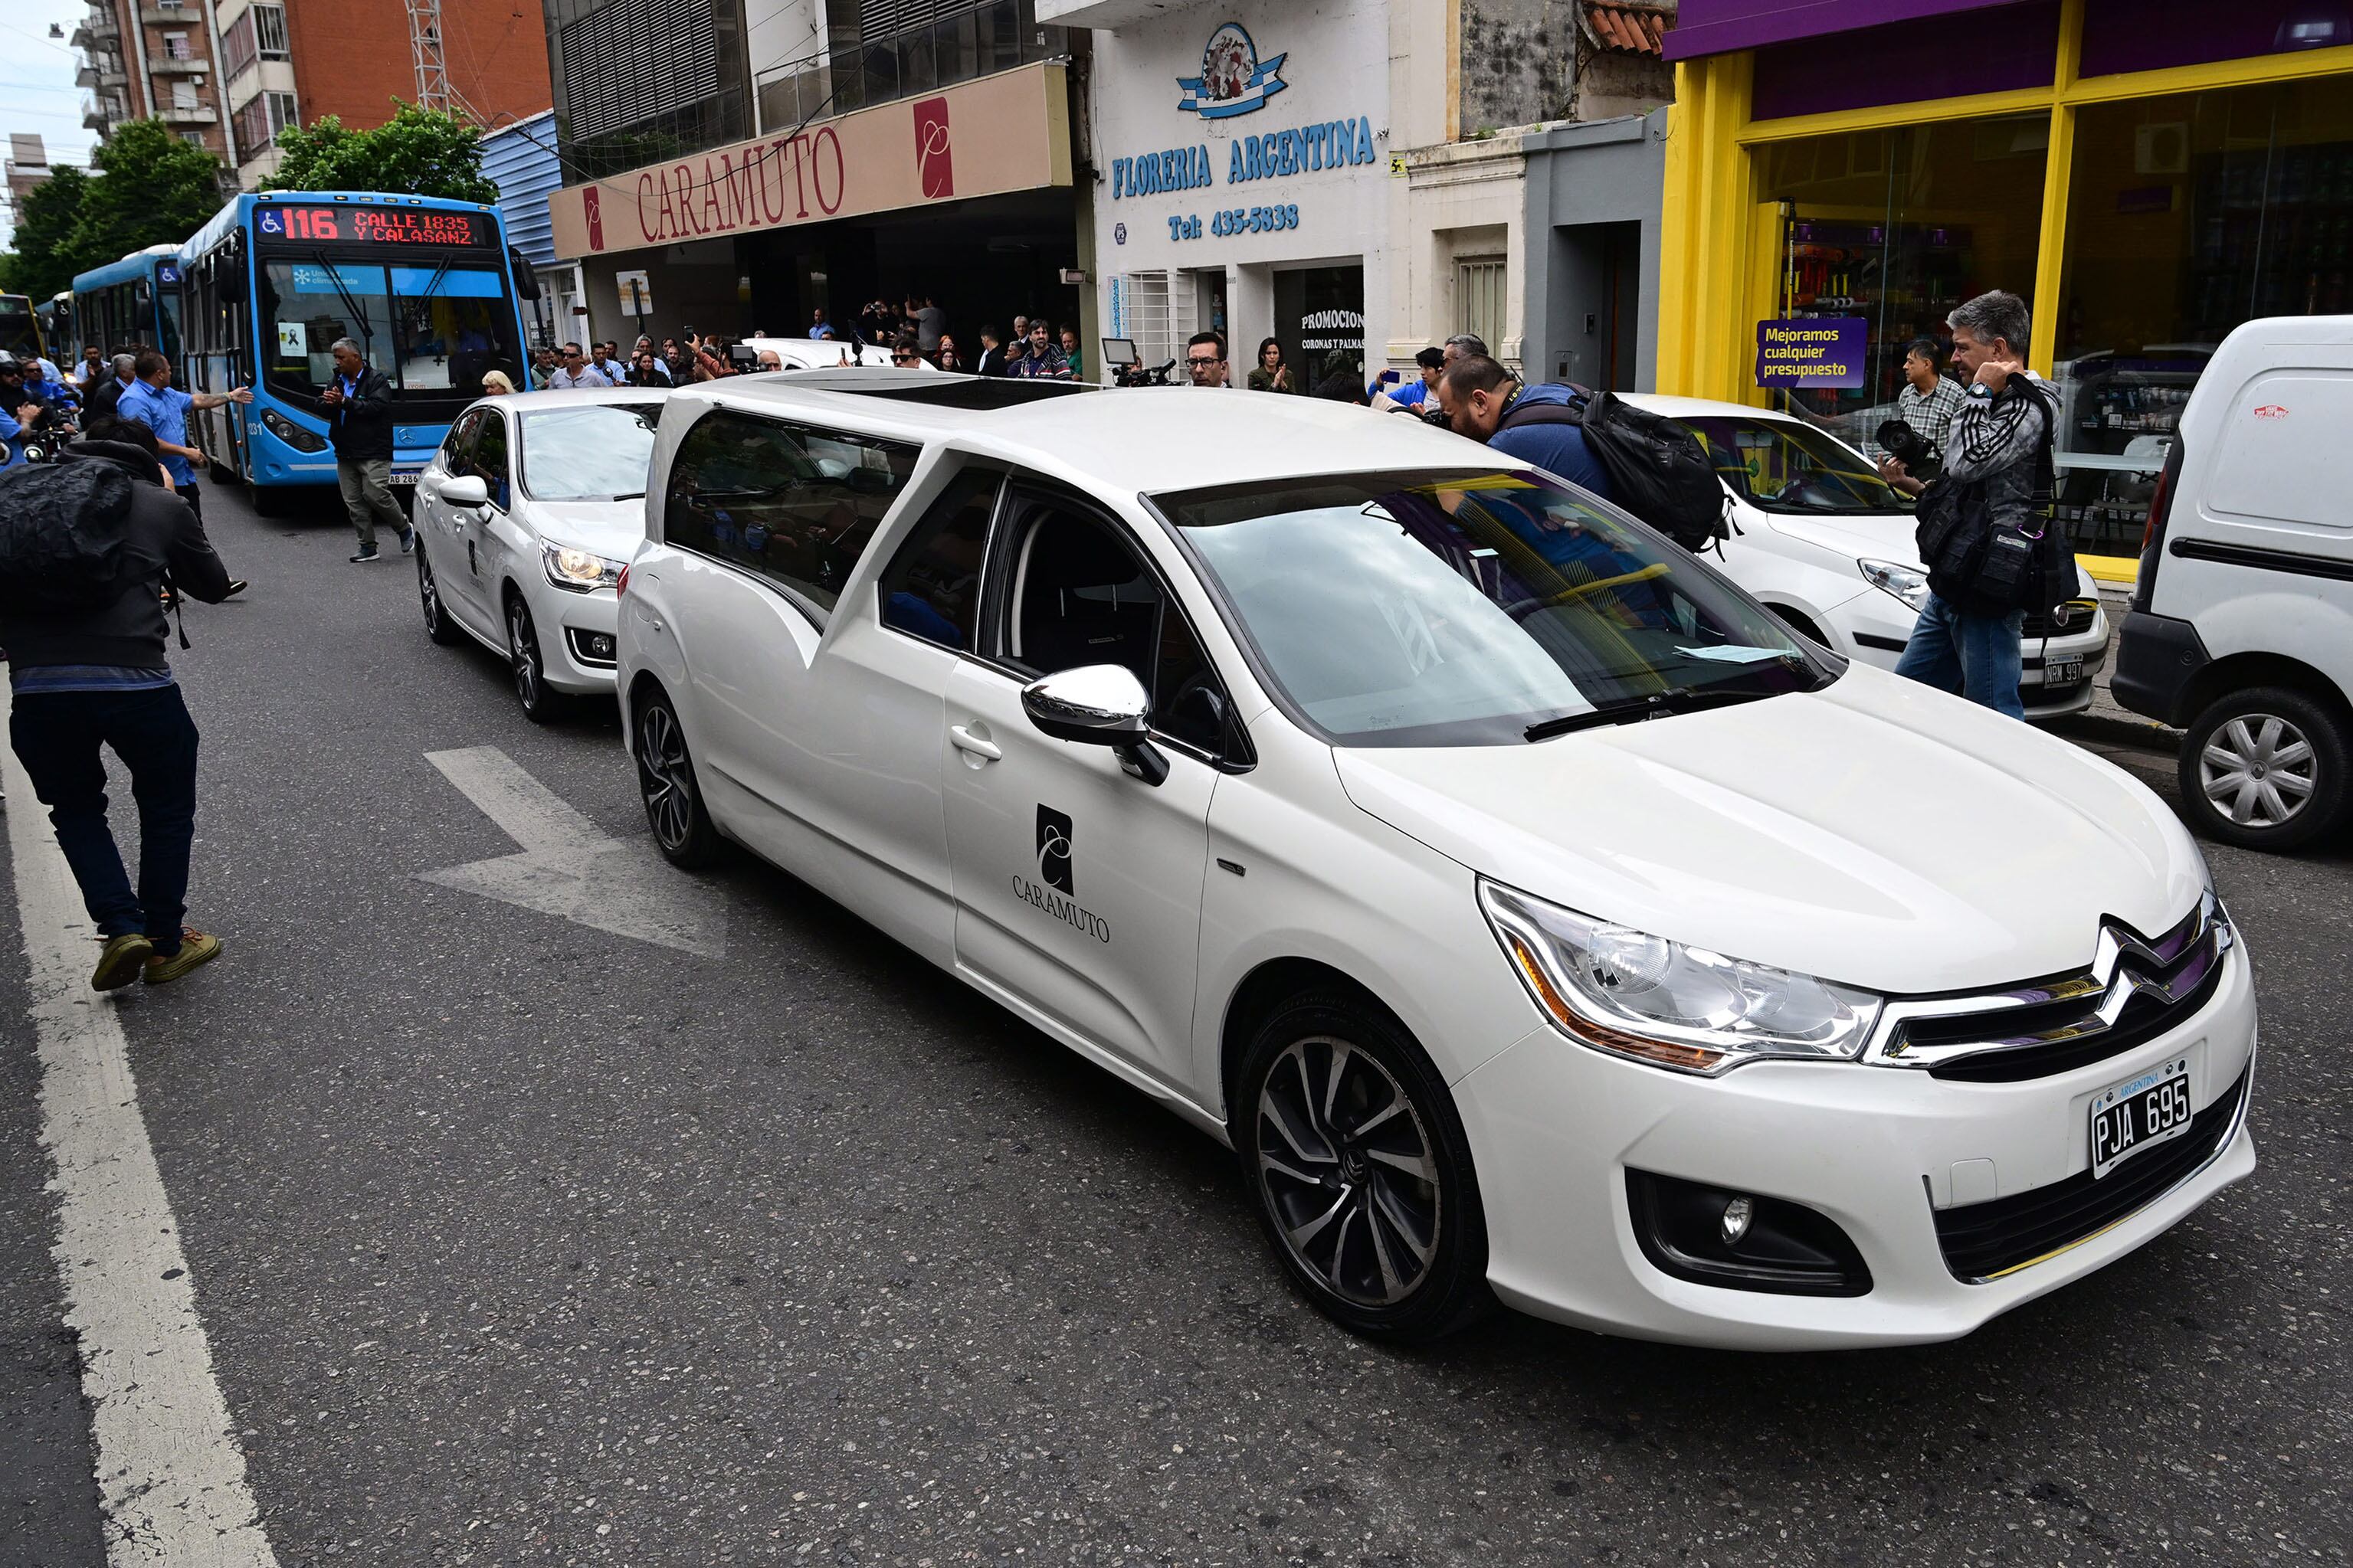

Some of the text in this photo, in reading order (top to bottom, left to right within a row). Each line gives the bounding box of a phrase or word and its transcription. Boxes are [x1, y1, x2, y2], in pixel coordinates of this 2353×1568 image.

[1113, 115, 1375, 200] FLORERIA ARGENTINA
[637, 126, 844, 242] CARAMUTO
[282, 208, 468, 239] 116 CALLE 1835
[1168, 204, 1299, 241] Tel: 435-5838
[355, 226, 471, 244] Y CALASANZ
[1301, 309, 1365, 329] PROMOCION
[1302, 339, 1365, 349] CORONAS Y PALMAS
[1765, 328, 1839, 345] Mejoramos
[1765, 345, 1825, 362] cualquier
[1764, 363, 1847, 378] presupuesto
[390, 475, 418, 483] AB 286
[2047, 663, 2082, 683] NRM 997
[1012, 875, 1110, 943] CARAMUTO
[2119, 1073, 2158, 1098] ARGENTINA
[2096, 1079, 2187, 1162] PJA 695
